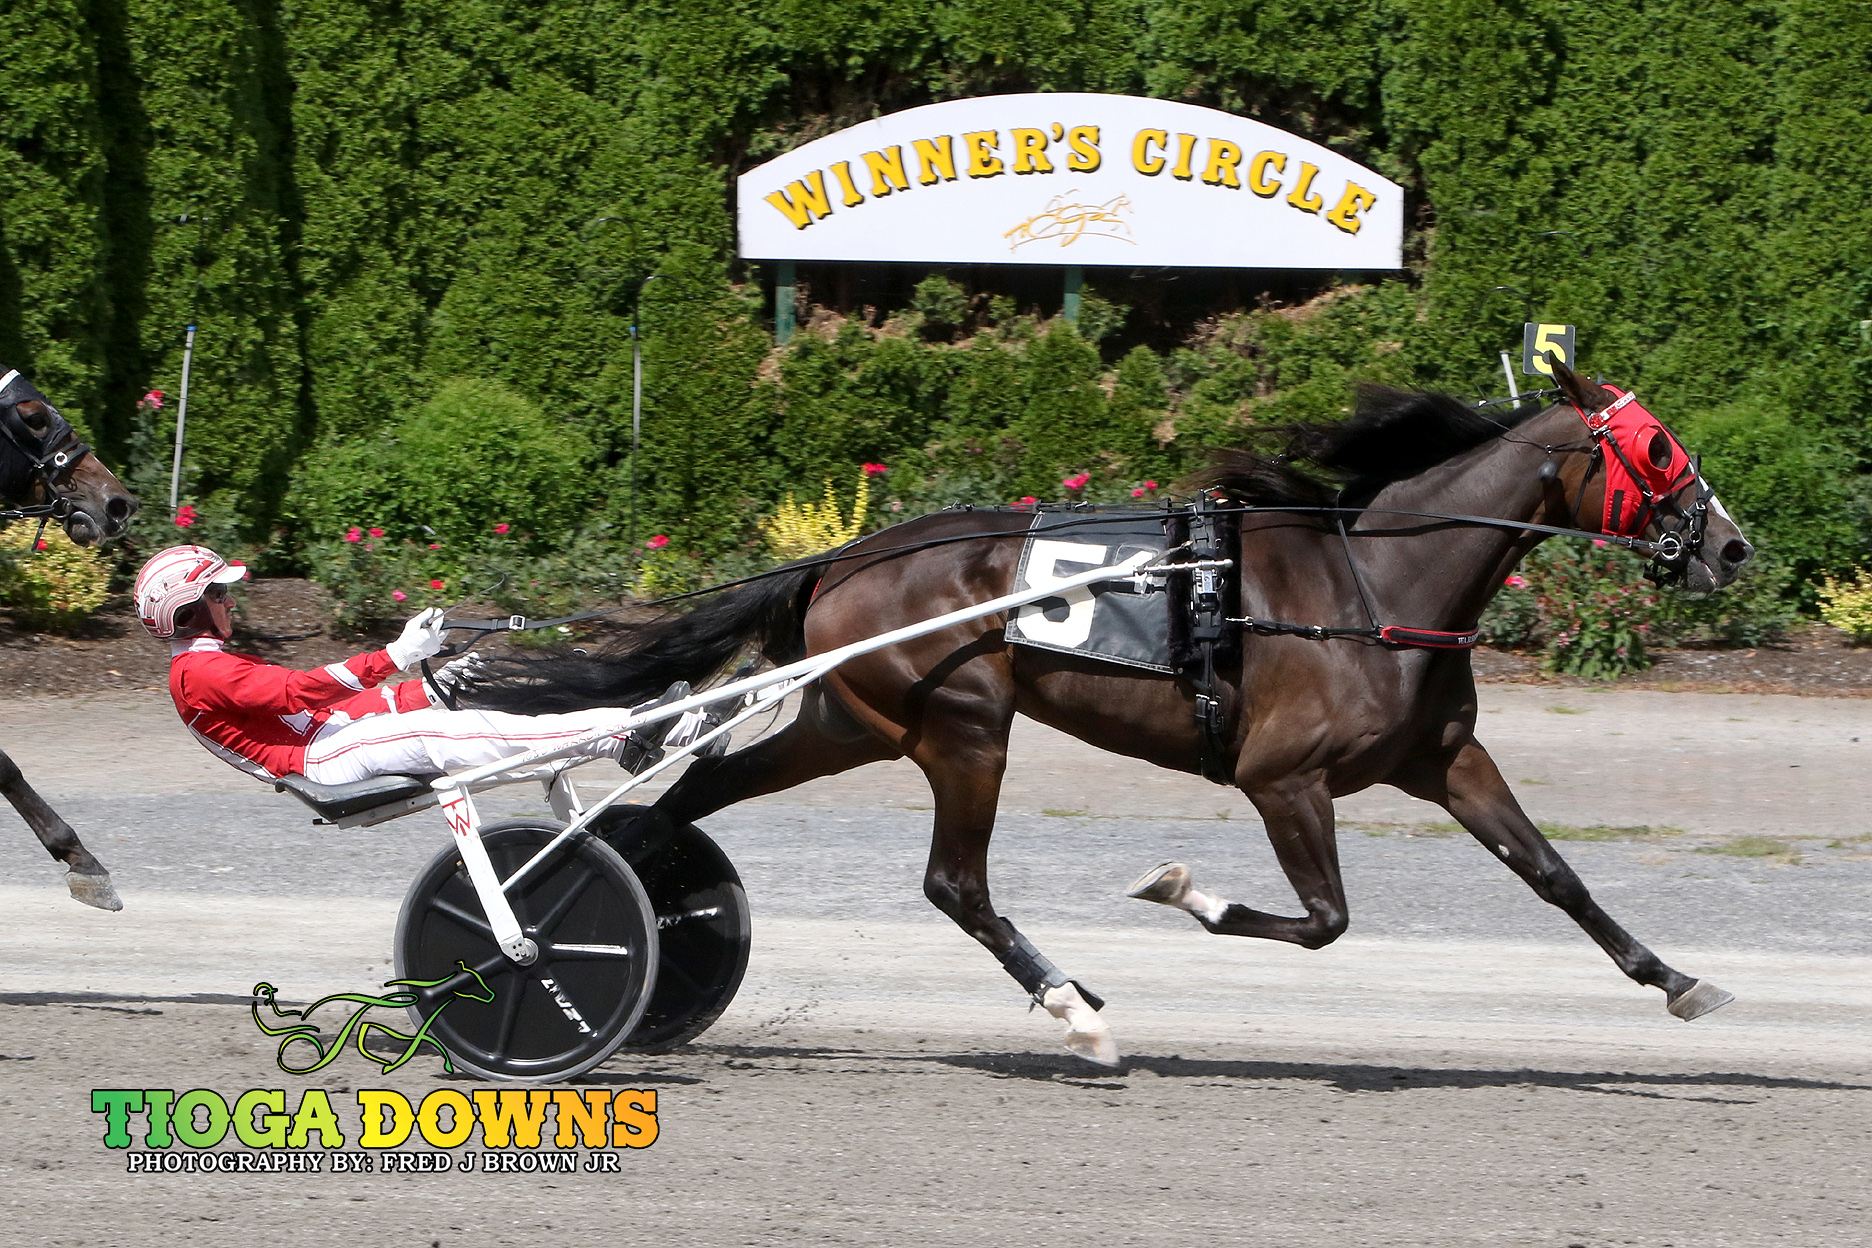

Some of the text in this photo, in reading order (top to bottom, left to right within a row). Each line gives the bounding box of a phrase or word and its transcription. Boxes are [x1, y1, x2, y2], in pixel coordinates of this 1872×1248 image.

[765, 122, 1377, 236] WINNER'S CIRCLE
[1532, 323, 1567, 375] 5
[1016, 538, 1107, 649] 5
